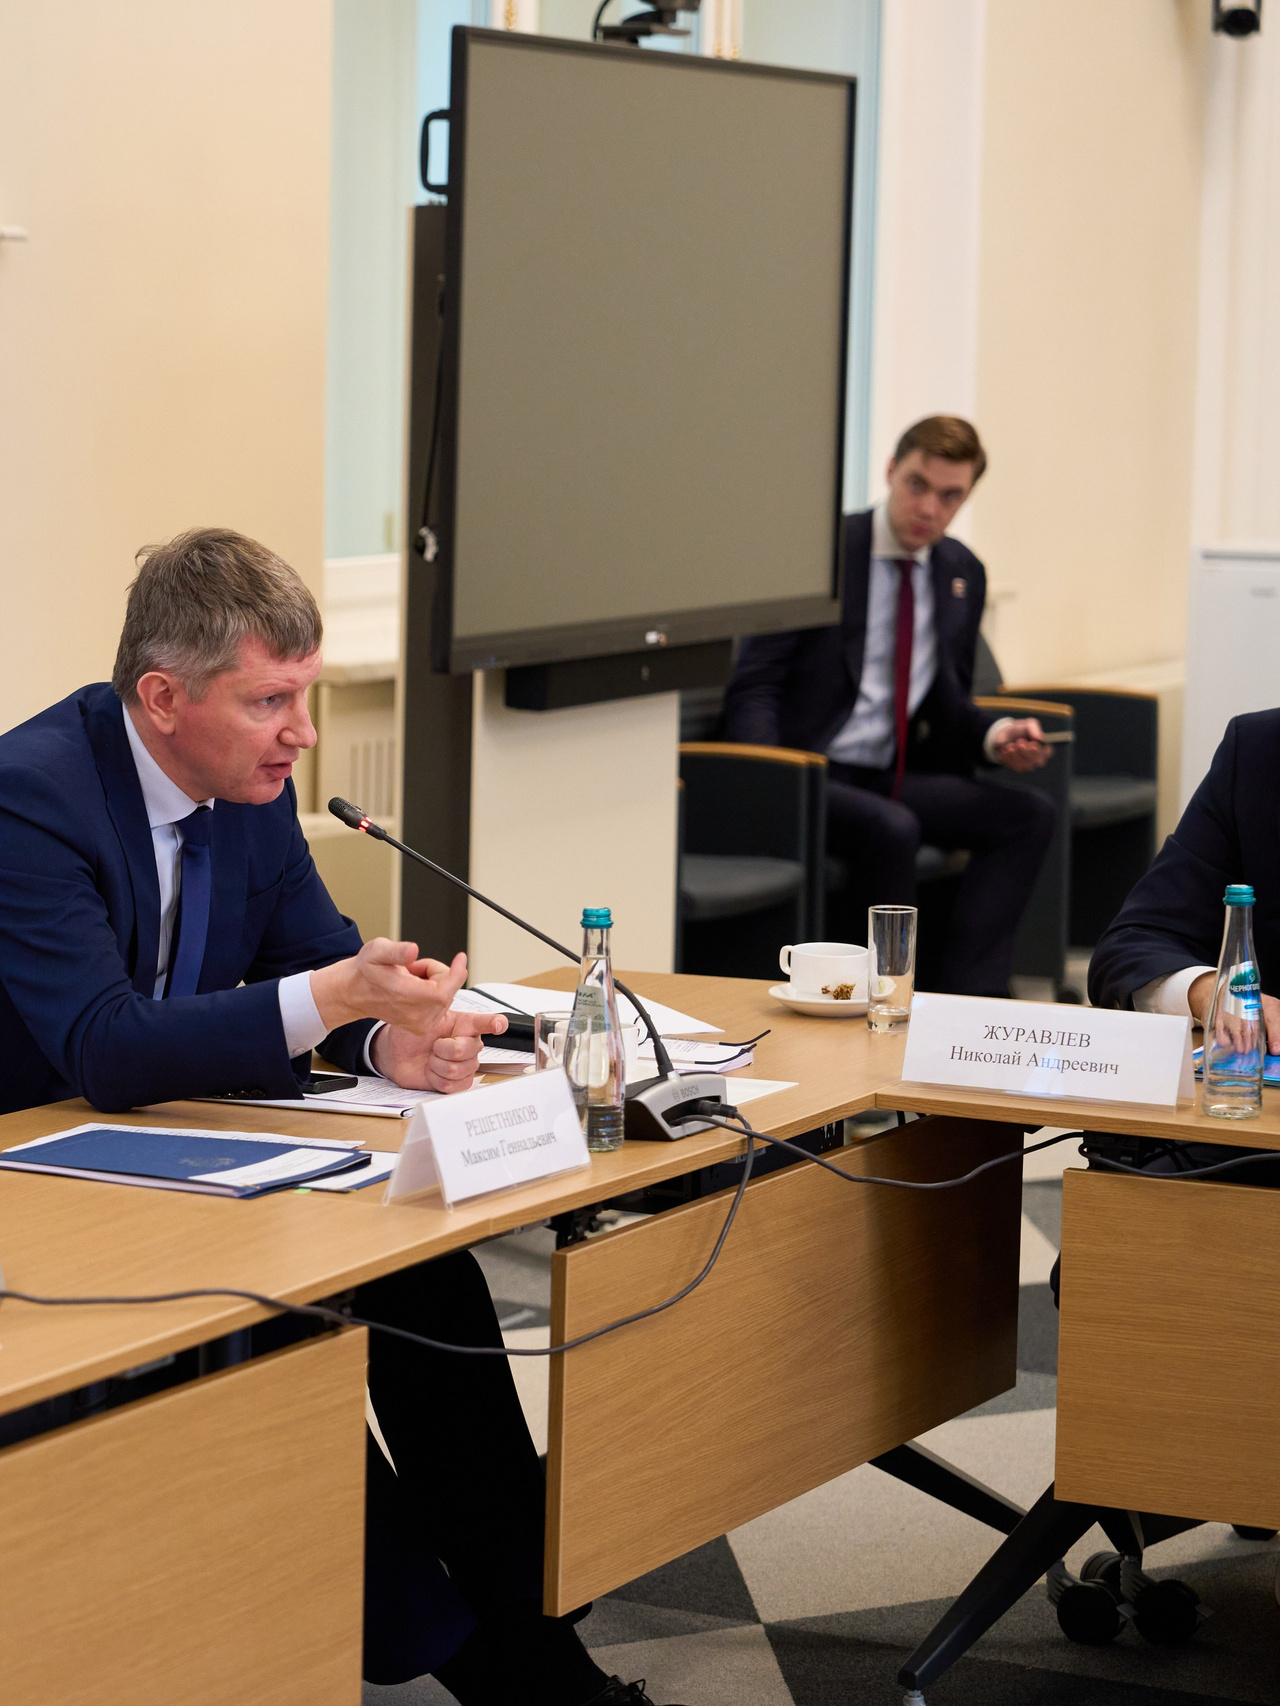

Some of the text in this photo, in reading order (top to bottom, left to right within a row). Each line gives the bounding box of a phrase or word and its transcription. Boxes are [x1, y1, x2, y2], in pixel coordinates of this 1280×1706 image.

[983, 1024, 1092, 1048] ЖУРАВЛЕВ
[949, 1045, 1120, 1076] Николай Андреевич
[680, 1085, 700, 1098] BOSCH
[464, 1104, 539, 1138] РЕШЕТНИКОВ
[460, 1131, 557, 1167] Максим Геннадьевич
